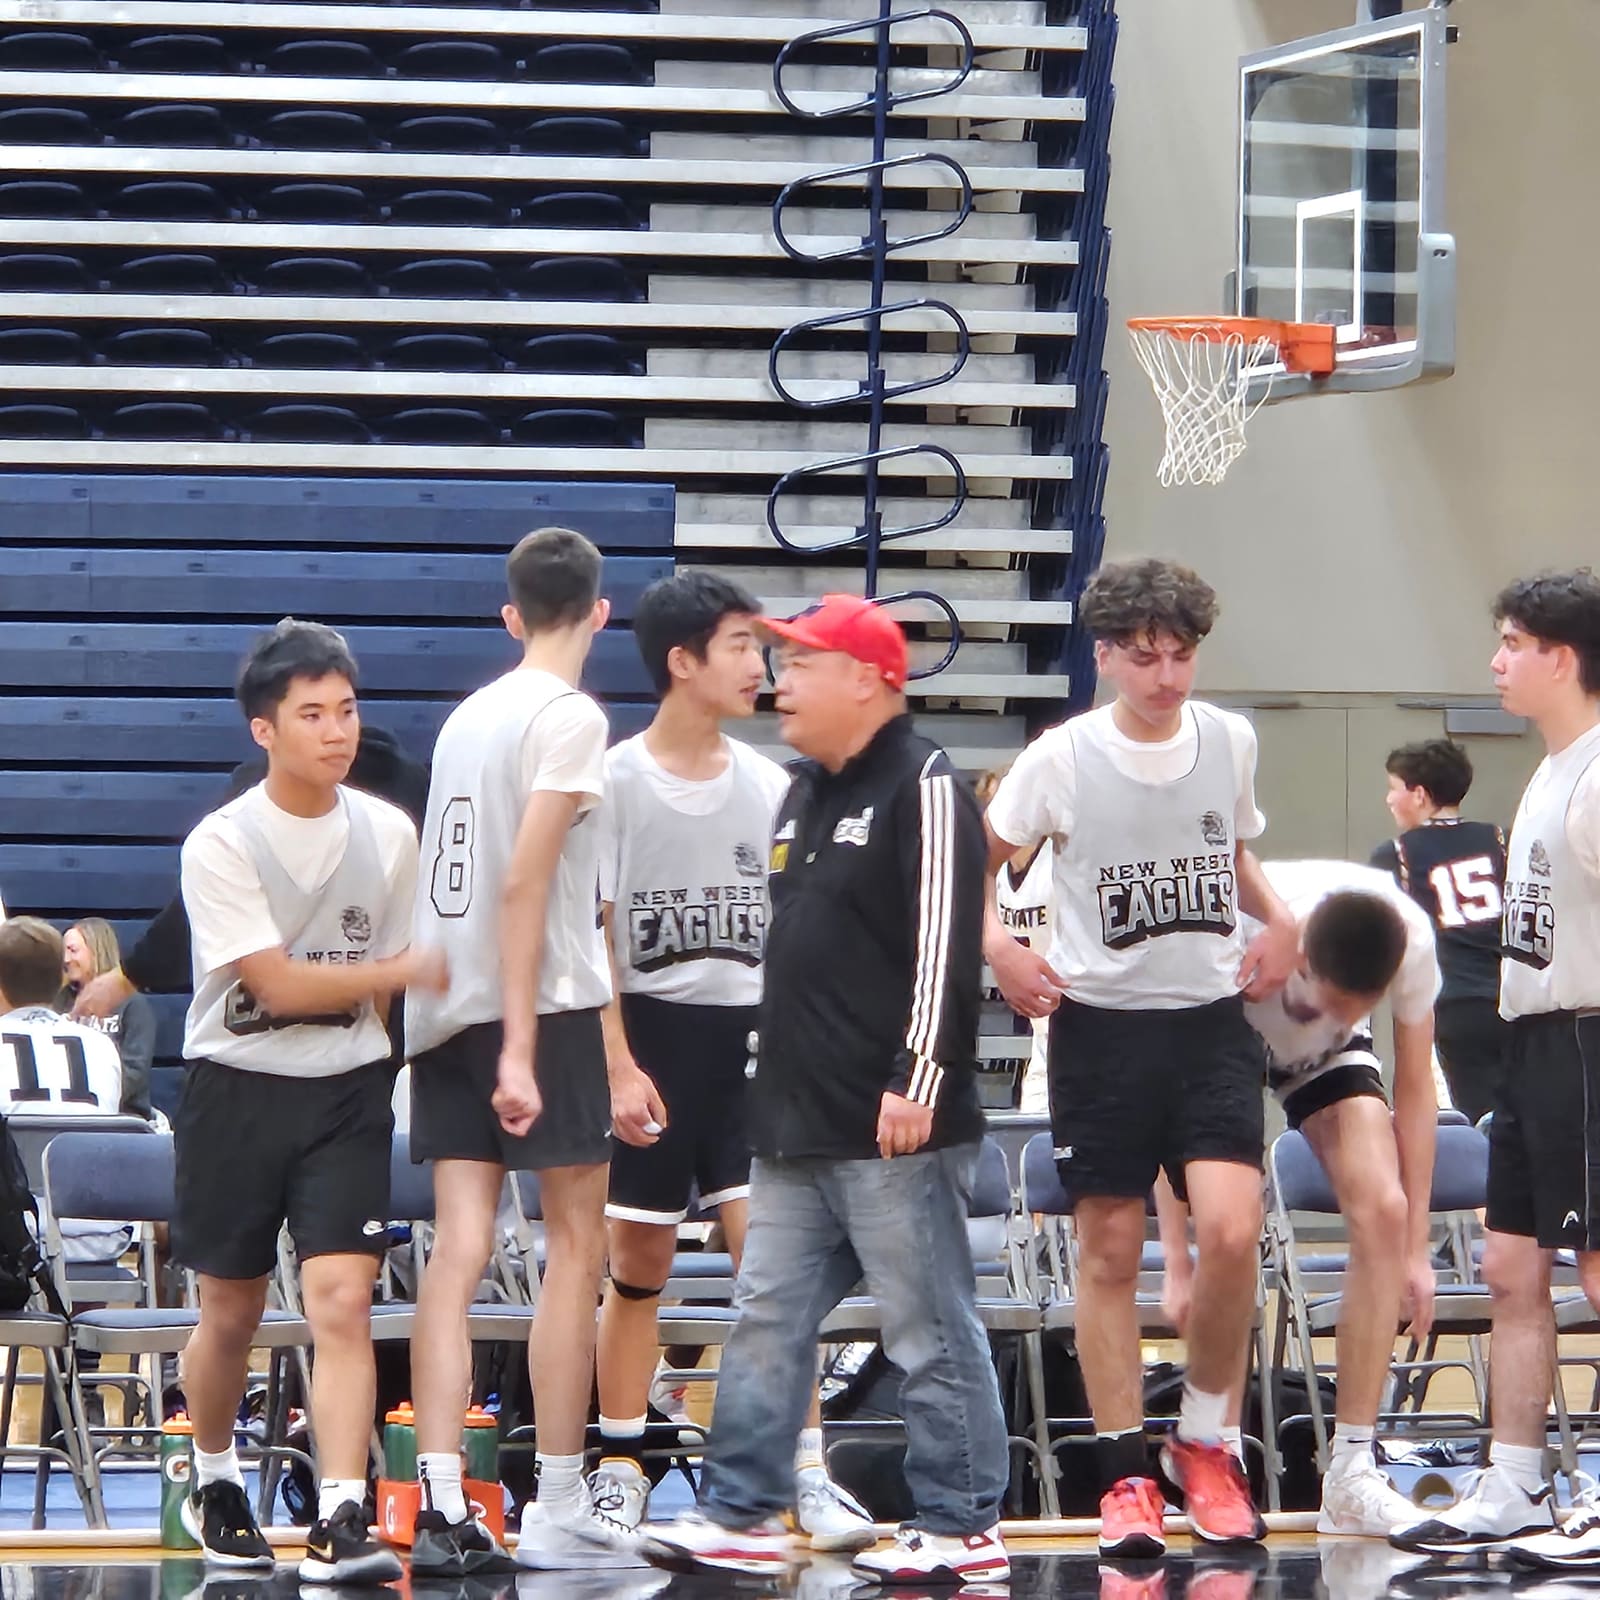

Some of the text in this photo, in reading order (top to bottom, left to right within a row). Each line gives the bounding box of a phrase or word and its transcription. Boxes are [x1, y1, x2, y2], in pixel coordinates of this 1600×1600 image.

[431, 797, 476, 918] 8
[1099, 853, 1230, 881] NEW WEST
[1429, 855, 1503, 927] 15
[629, 903, 766, 973] EAGLES
[1097, 871, 1237, 950] EAGLES
[1, 1033, 99, 1107] 11
